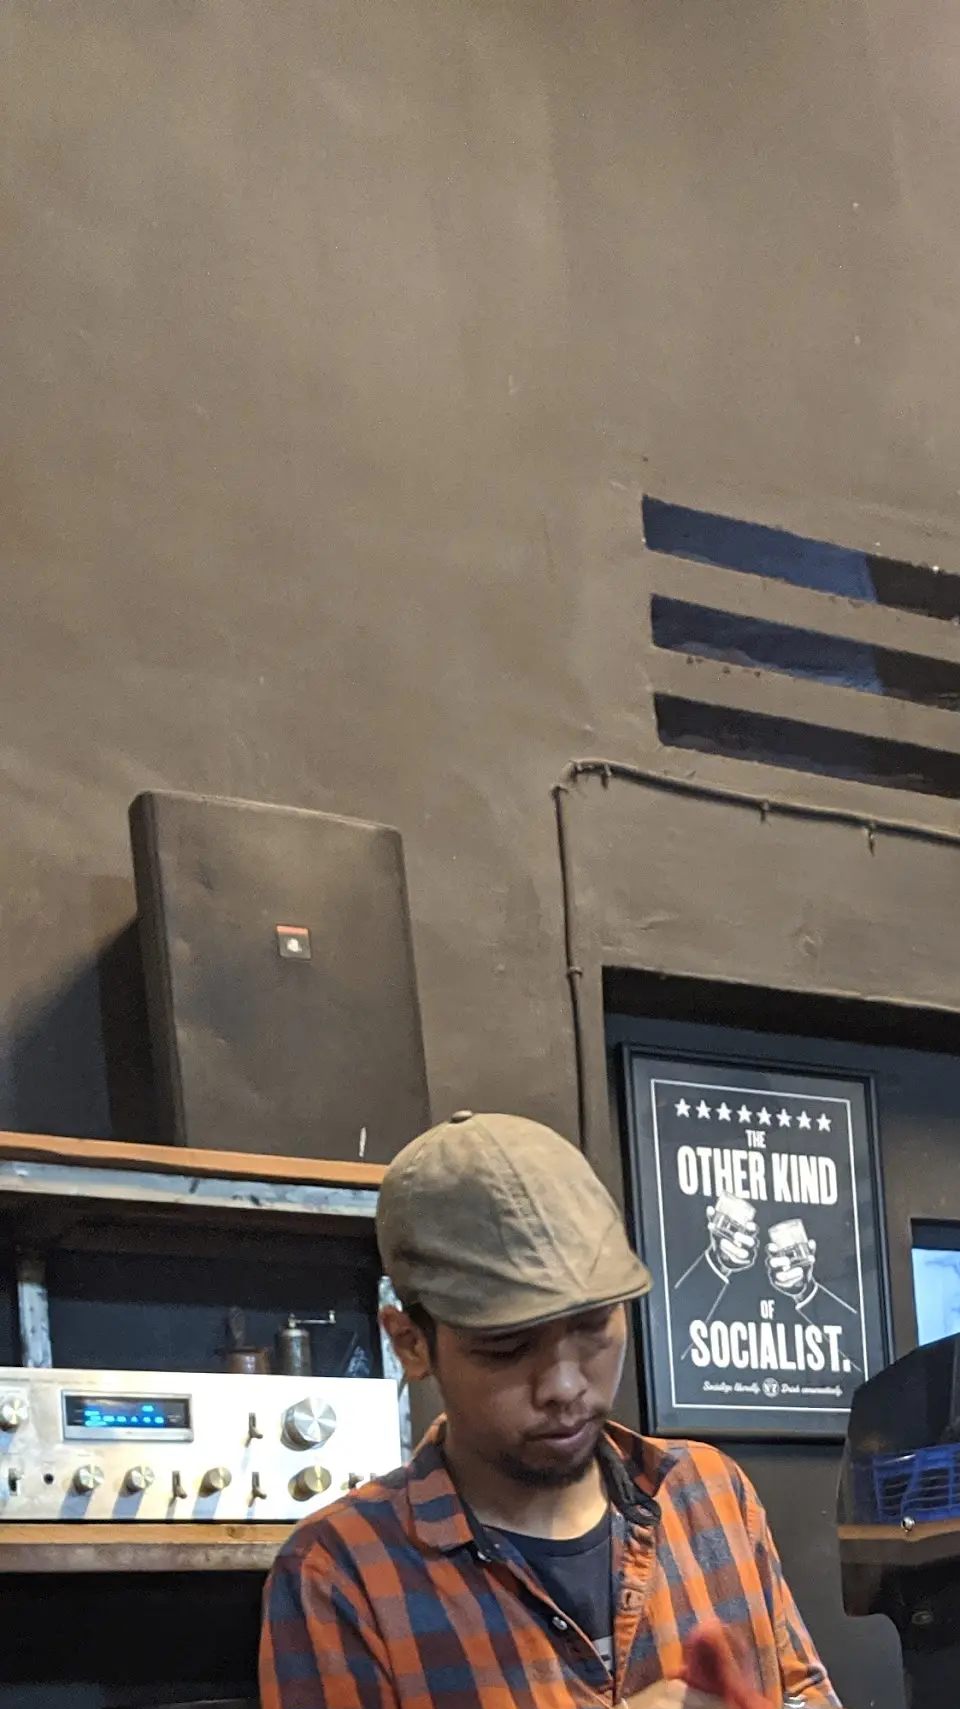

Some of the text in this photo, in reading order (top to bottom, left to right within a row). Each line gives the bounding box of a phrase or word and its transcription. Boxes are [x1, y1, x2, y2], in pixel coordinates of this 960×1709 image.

[745, 1129, 766, 1148] THE
[676, 1145, 838, 1205] OTHER KIND
[760, 1299, 775, 1319] OF
[688, 1319, 852, 1373] SOCIALIST.
